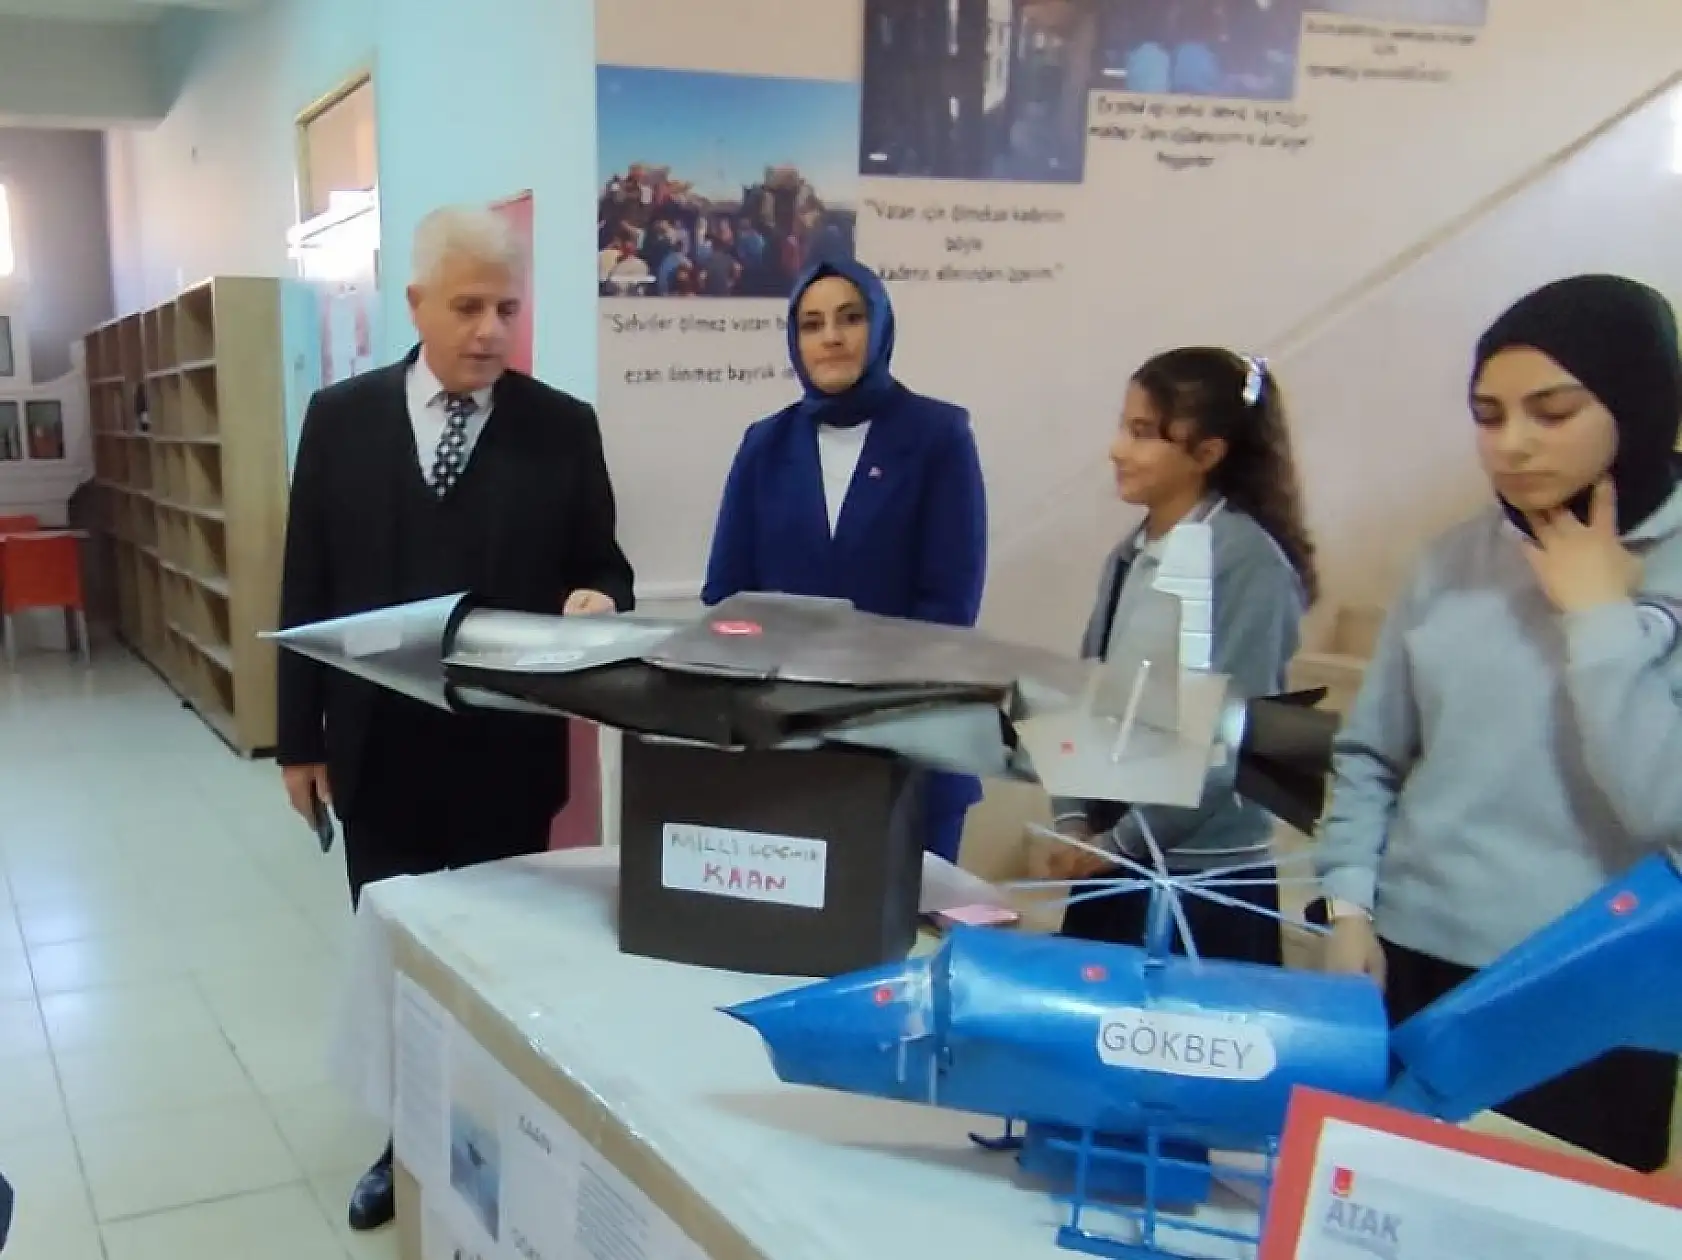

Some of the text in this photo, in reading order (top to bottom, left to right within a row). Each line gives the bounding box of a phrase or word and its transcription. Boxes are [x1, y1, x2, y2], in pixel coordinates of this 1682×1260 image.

[703, 861, 787, 891] KAAN
[1103, 1012, 1254, 1070] GÖKBEY
[1326, 1200, 1402, 1242] ATAK
